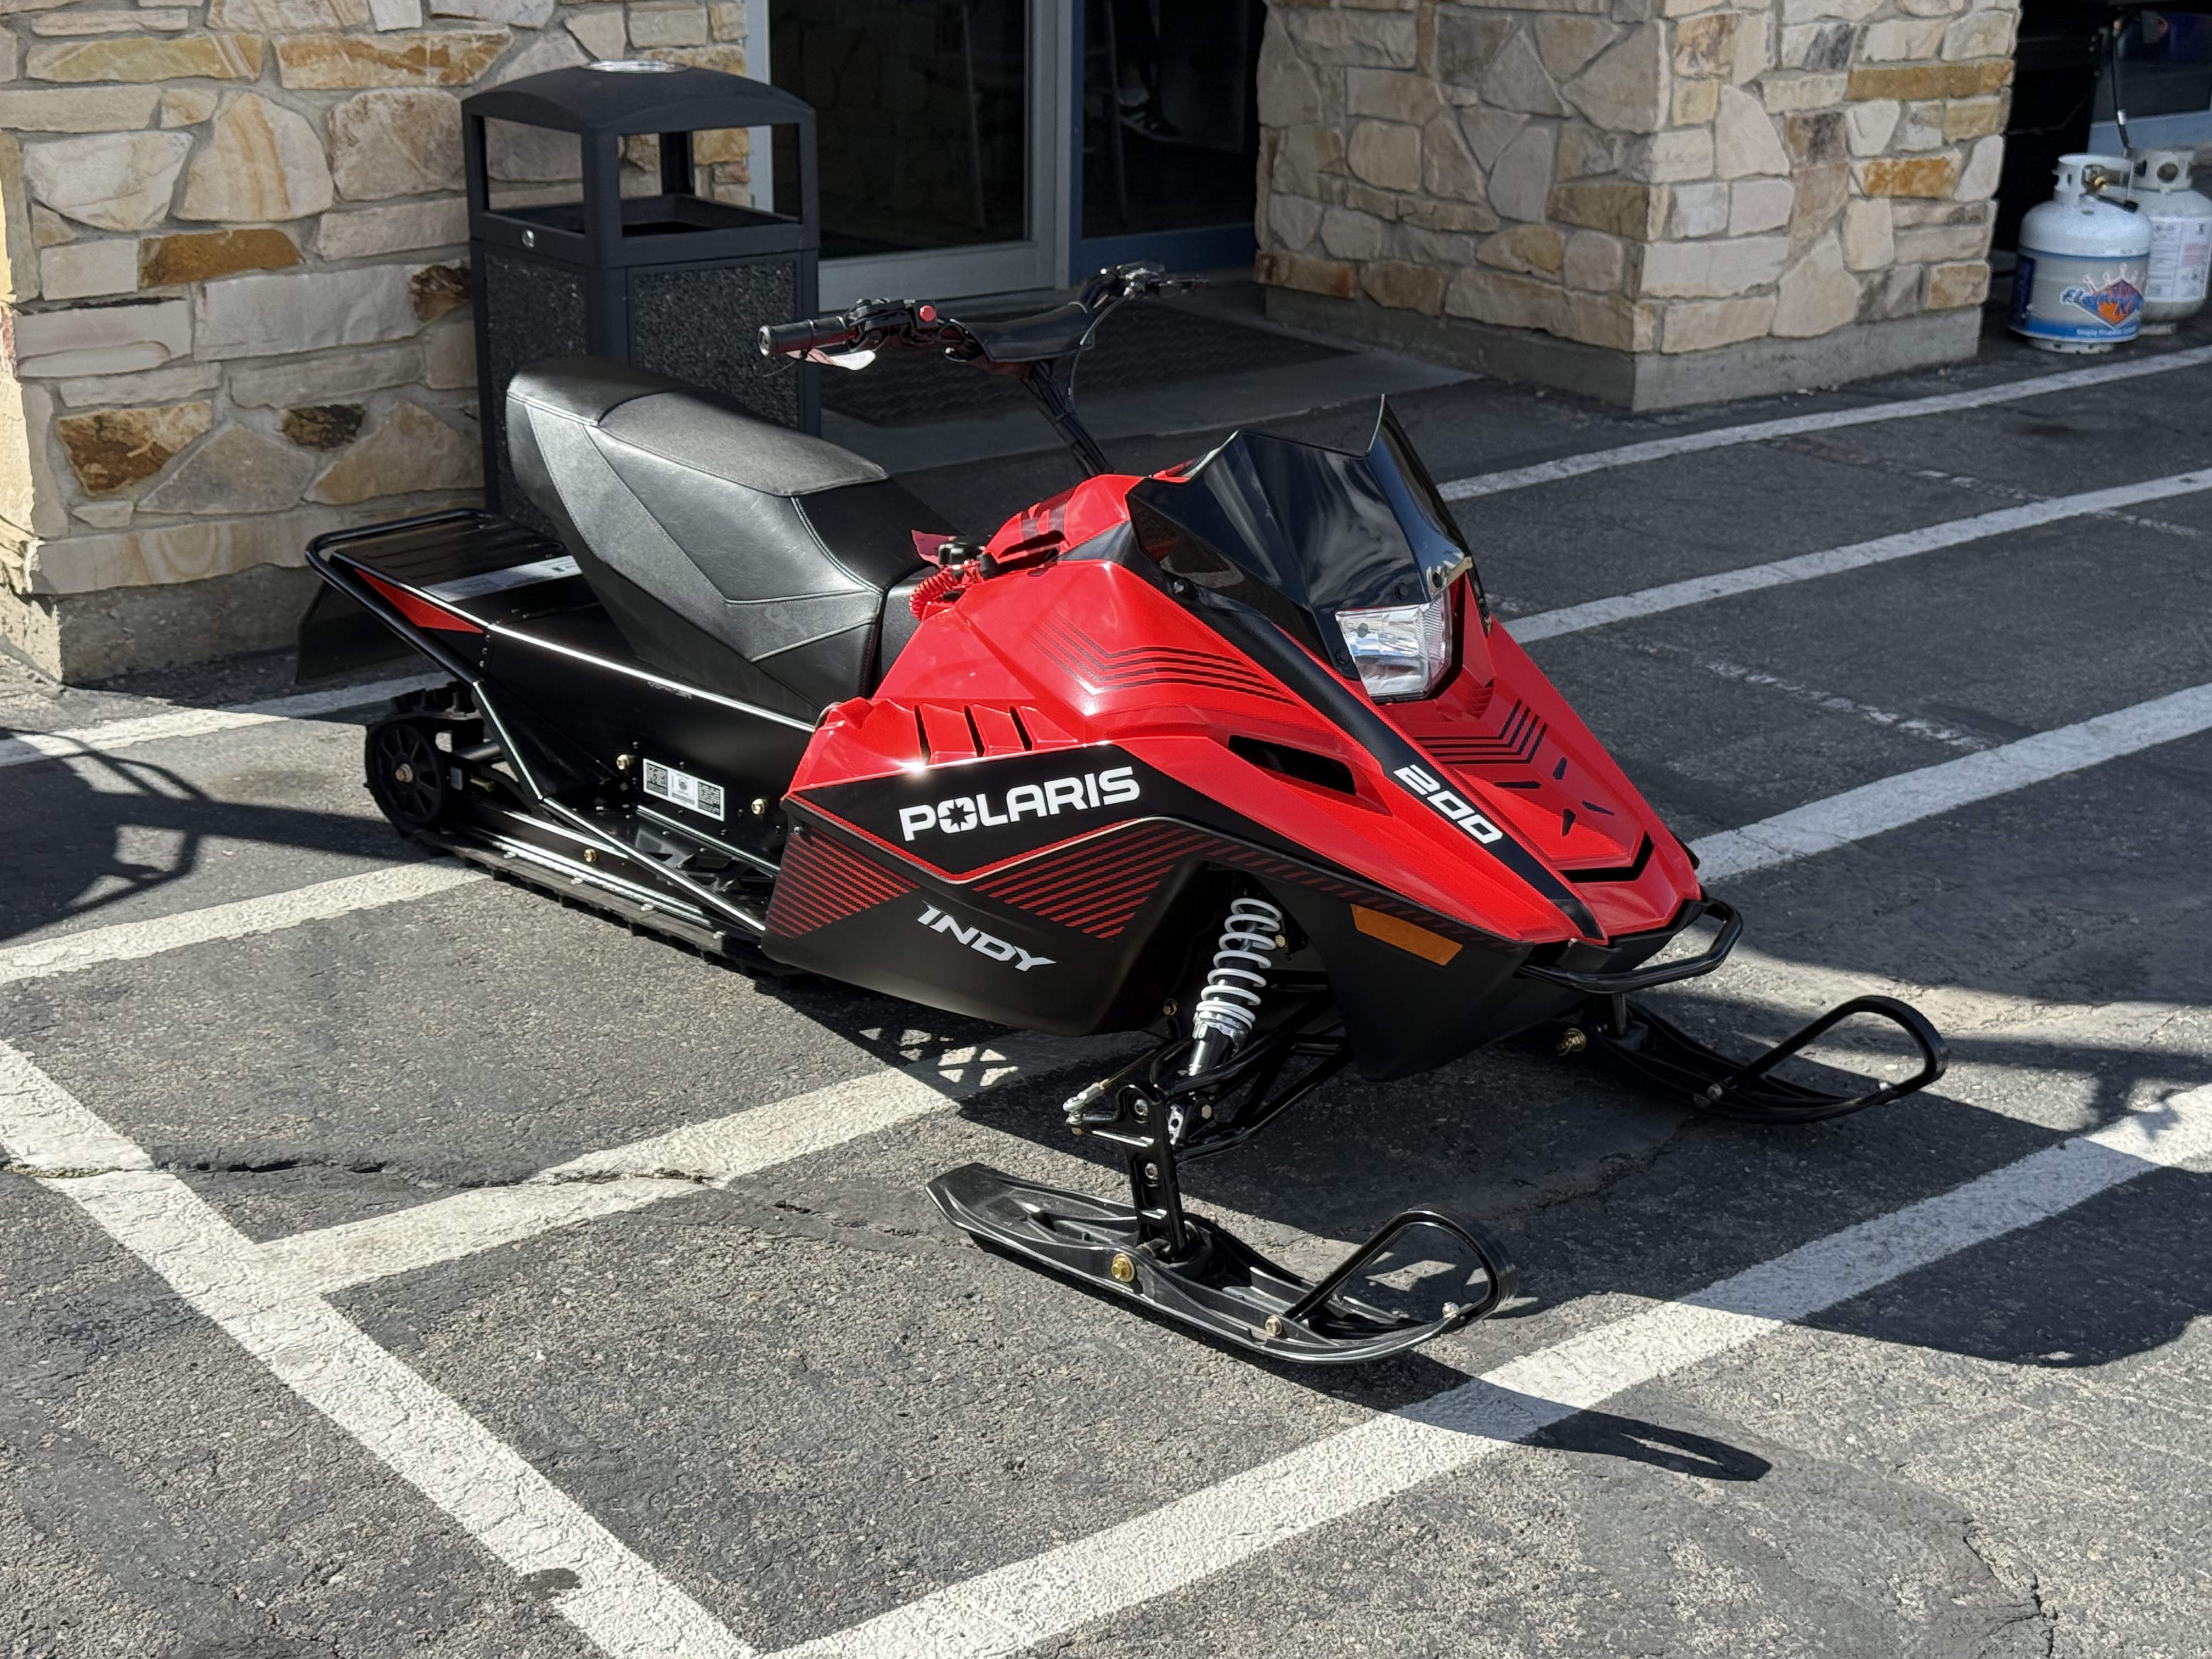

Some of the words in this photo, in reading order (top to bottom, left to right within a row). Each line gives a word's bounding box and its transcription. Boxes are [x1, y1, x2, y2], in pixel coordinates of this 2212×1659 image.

[899, 766, 1141, 842] POLARIS
[1393, 764, 1503, 844] 200
[917, 902, 1057, 972] INDY
